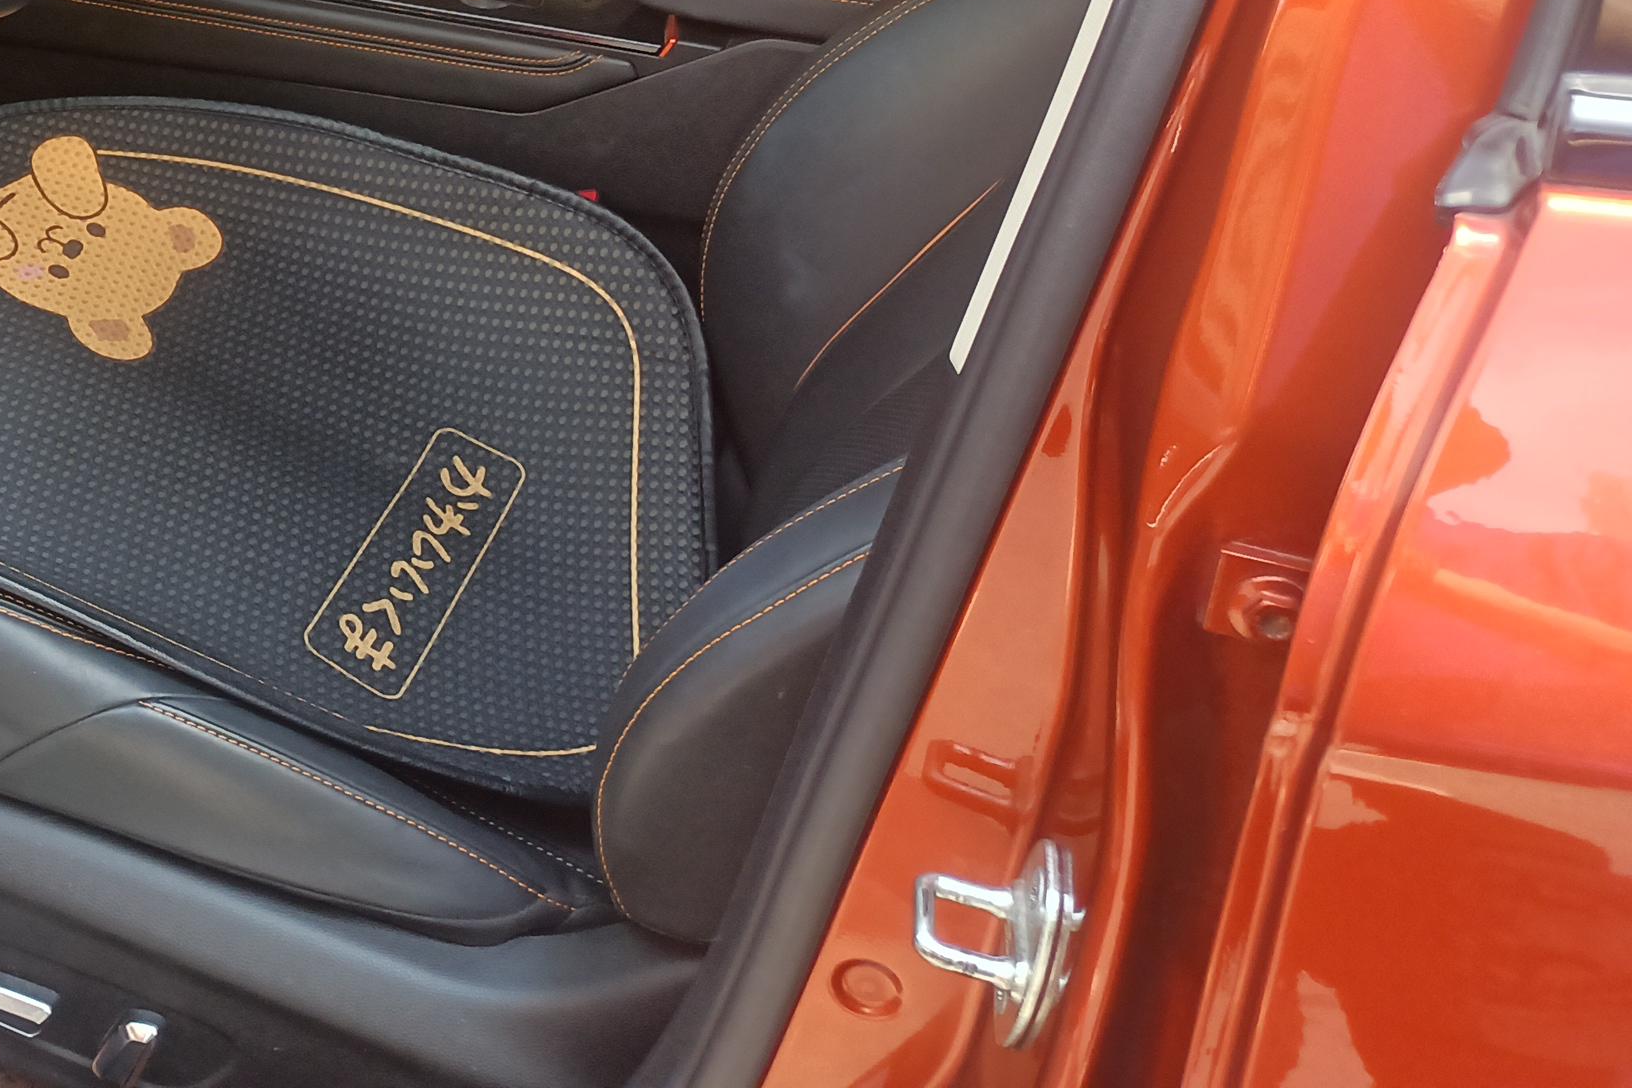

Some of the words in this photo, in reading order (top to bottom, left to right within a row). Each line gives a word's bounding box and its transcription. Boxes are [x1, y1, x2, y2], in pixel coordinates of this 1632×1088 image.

[338, 454, 493, 672] かわいいくま
